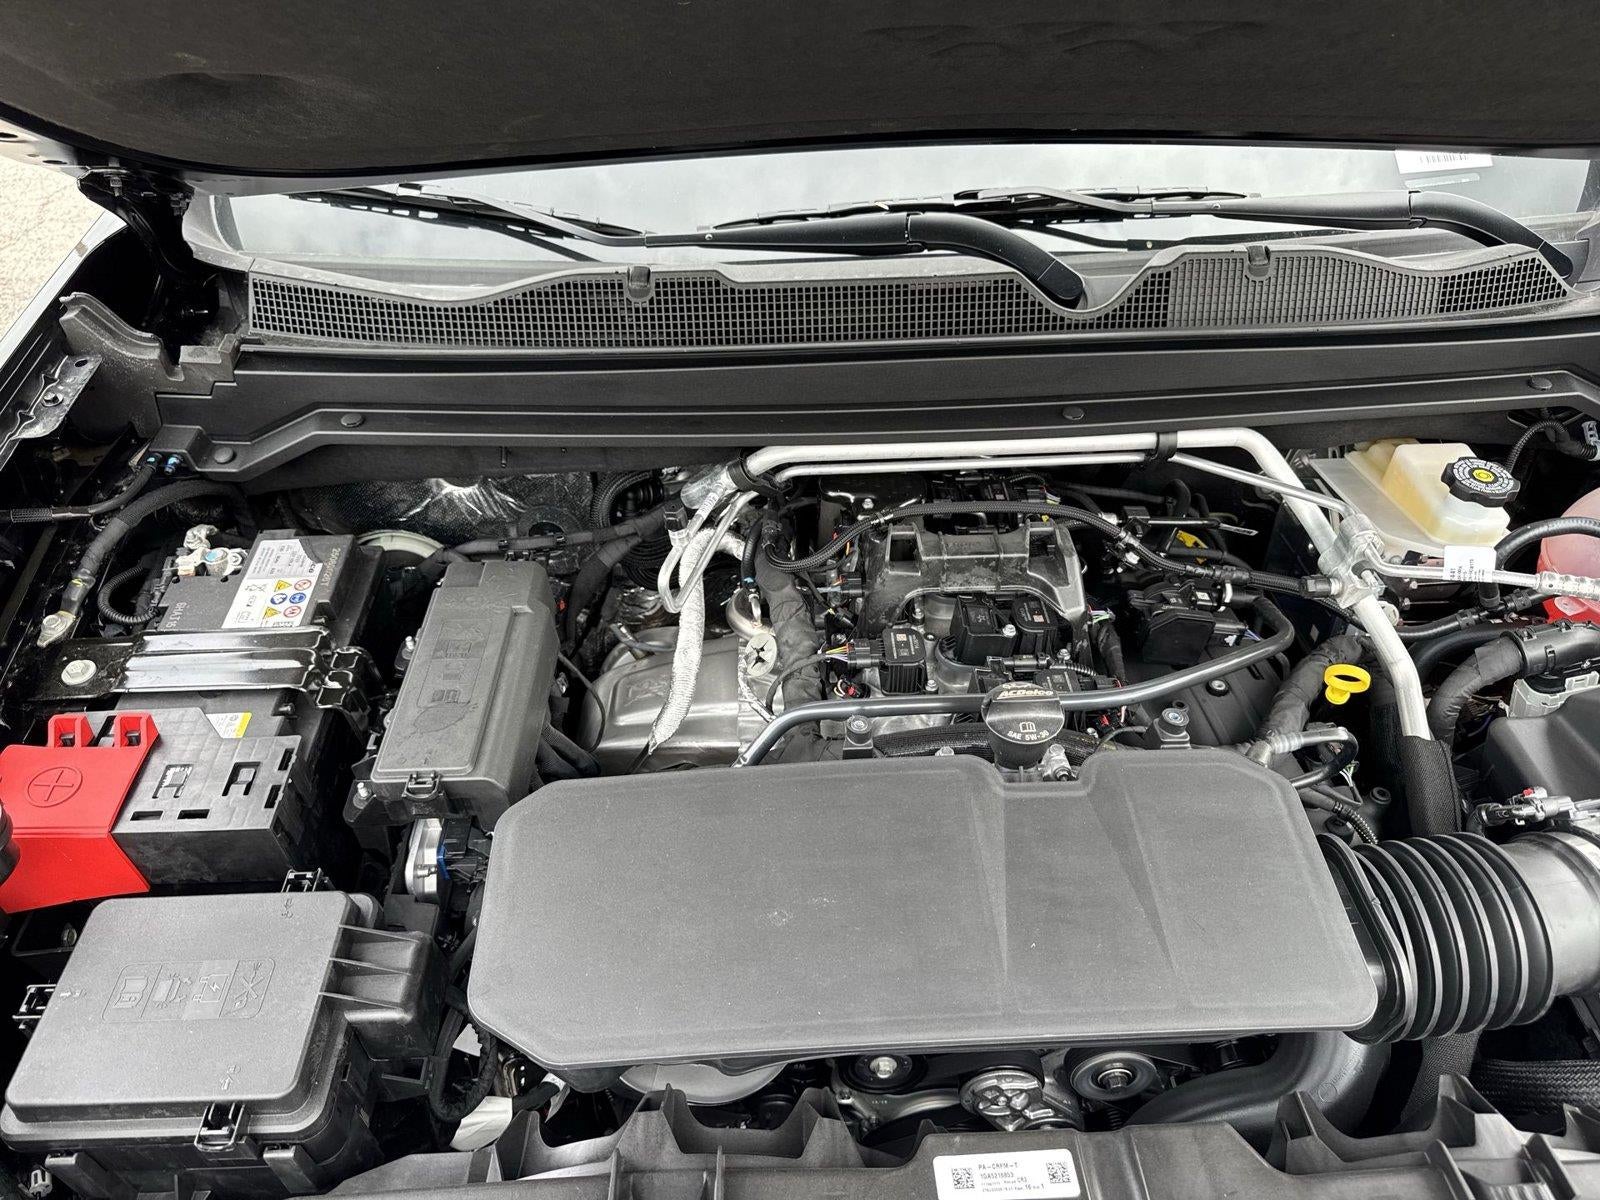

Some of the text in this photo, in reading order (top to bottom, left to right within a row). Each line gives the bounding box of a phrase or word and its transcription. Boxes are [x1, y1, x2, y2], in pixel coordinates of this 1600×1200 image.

[999, 689, 1054, 698] ACDelco
[1007, 730, 1049, 741] SAE 5W-30
